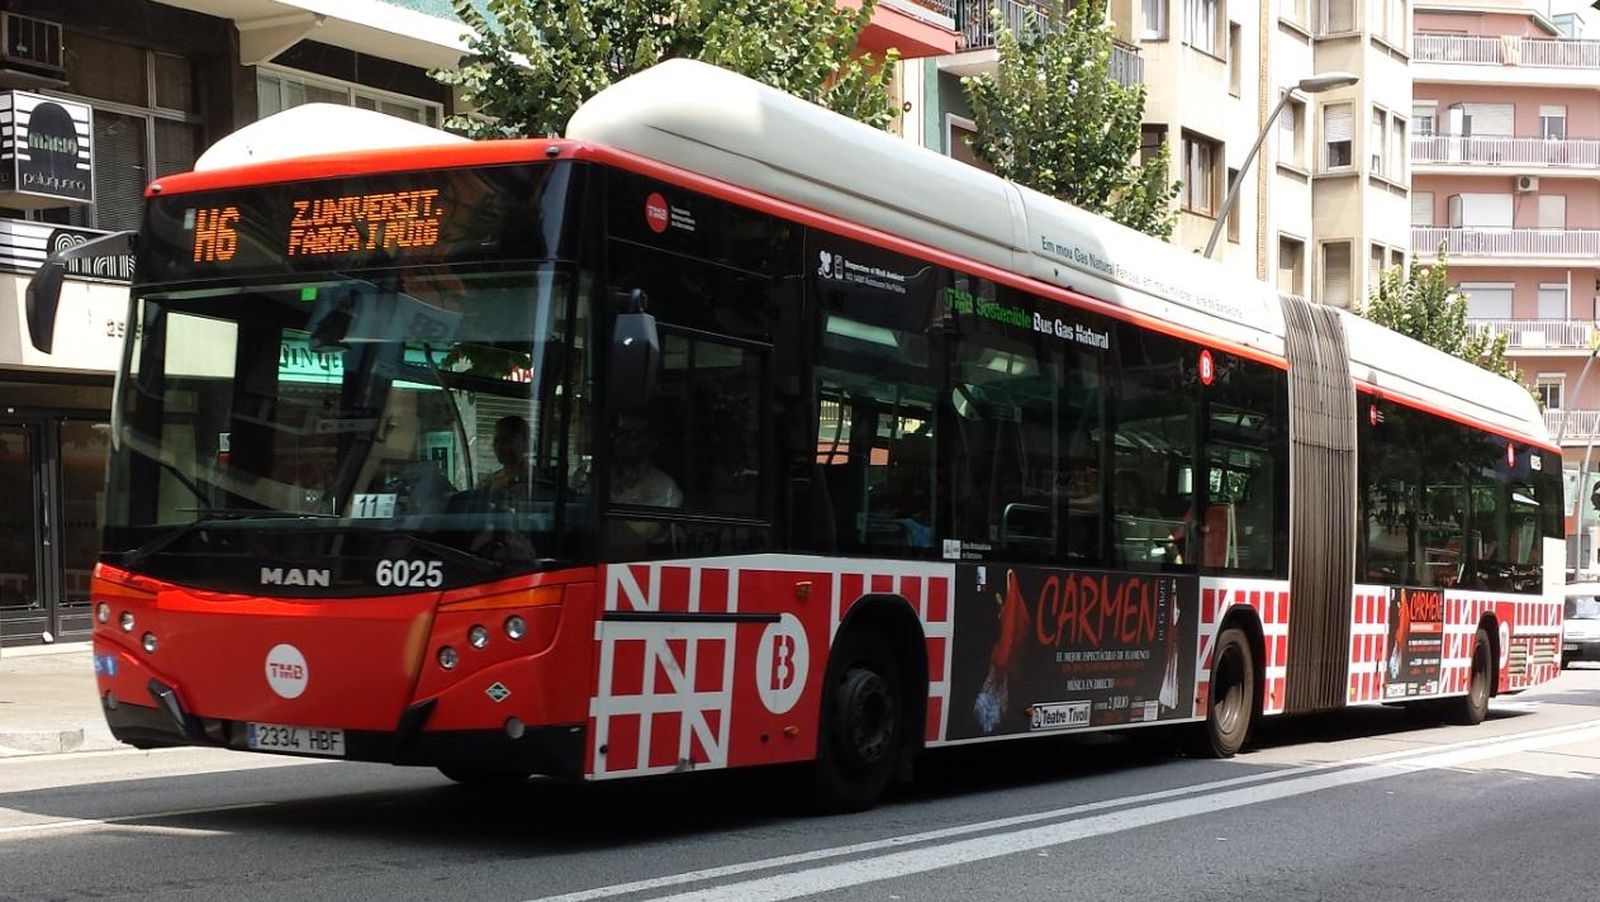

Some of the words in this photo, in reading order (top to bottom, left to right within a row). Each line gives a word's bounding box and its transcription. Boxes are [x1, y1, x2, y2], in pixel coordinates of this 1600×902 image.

[194, 206, 240, 263] H6
[288, 225, 360, 256] FABRA
[383, 218, 439, 248] PUIG
[1041, 236, 1054, 253] Em
[1074, 247, 1088, 265] Gas
[1089, 252, 1115, 275] Natural
[1033, 312, 1053, 334] Bus
[1055, 318, 1074, 340] Gas
[1075, 323, 1109, 349] Natural
[359, 495, 379, 517] 11
[260, 567, 330, 587] MAN
[376, 559, 443, 588] 6025
[1036, 572, 1159, 648] CARMEN
[1410, 592, 1440, 621] CARMEN
[270, 663, 304, 680] TMB
[770, 634, 796, 691] B
[1042, 709, 1066, 726] Teatre
[1068, 706, 1090, 724] Tivoli
[259, 726, 300, 748] 2334
[309, 730, 341, 751] HBF
